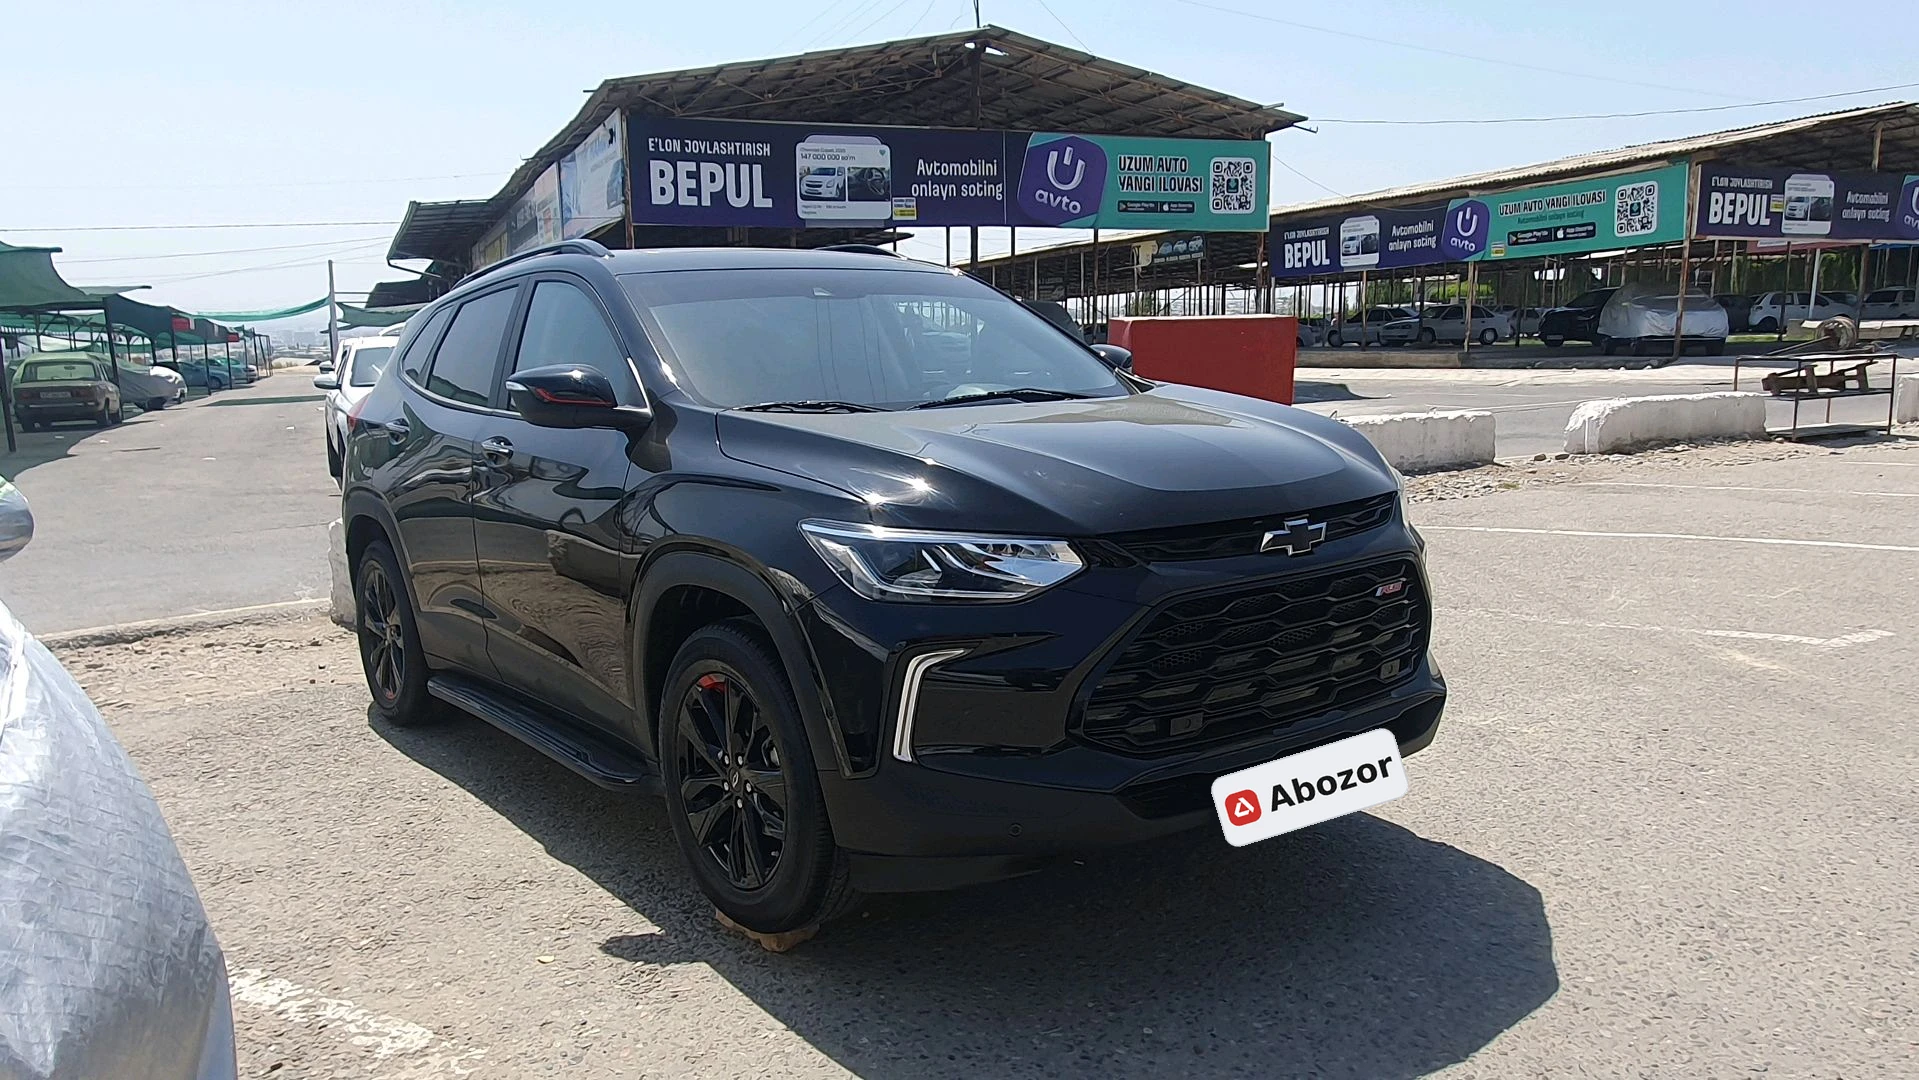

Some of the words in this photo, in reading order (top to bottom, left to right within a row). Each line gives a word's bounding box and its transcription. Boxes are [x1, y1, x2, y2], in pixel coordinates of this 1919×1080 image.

[648, 137, 681, 153] E'LON
[684, 140, 771, 157] JOYLASHTIRISH
[916, 158, 997, 176] Avtomobilni
[1118, 155, 1154, 173] UZUM
[1156, 156, 1188, 173] AVTO
[649, 159, 773, 208] BEPUL
[911, 179, 956, 201] onlayn
[961, 179, 1003, 201] soting
[1117, 175, 1155, 193] YANGI
[1159, 176, 1204, 193] ILOVASI
[1035, 189, 1081, 214] avto
[1499, 203, 1521, 217] UZUM
[1523, 199, 1543, 213] AVTO
[1545, 196, 1571, 210] YANGI
[1572, 190, 1606, 206] ILOVASI
[1708, 191, 1771, 226] BEPUL
[1391, 220, 1434, 237] Avtomobilni
[1388, 239, 1412, 252] onlayn
[1413, 235, 1437, 249] soting
[1450, 237, 1476, 252] avto
[1284, 239, 1331, 269] BEPUL
